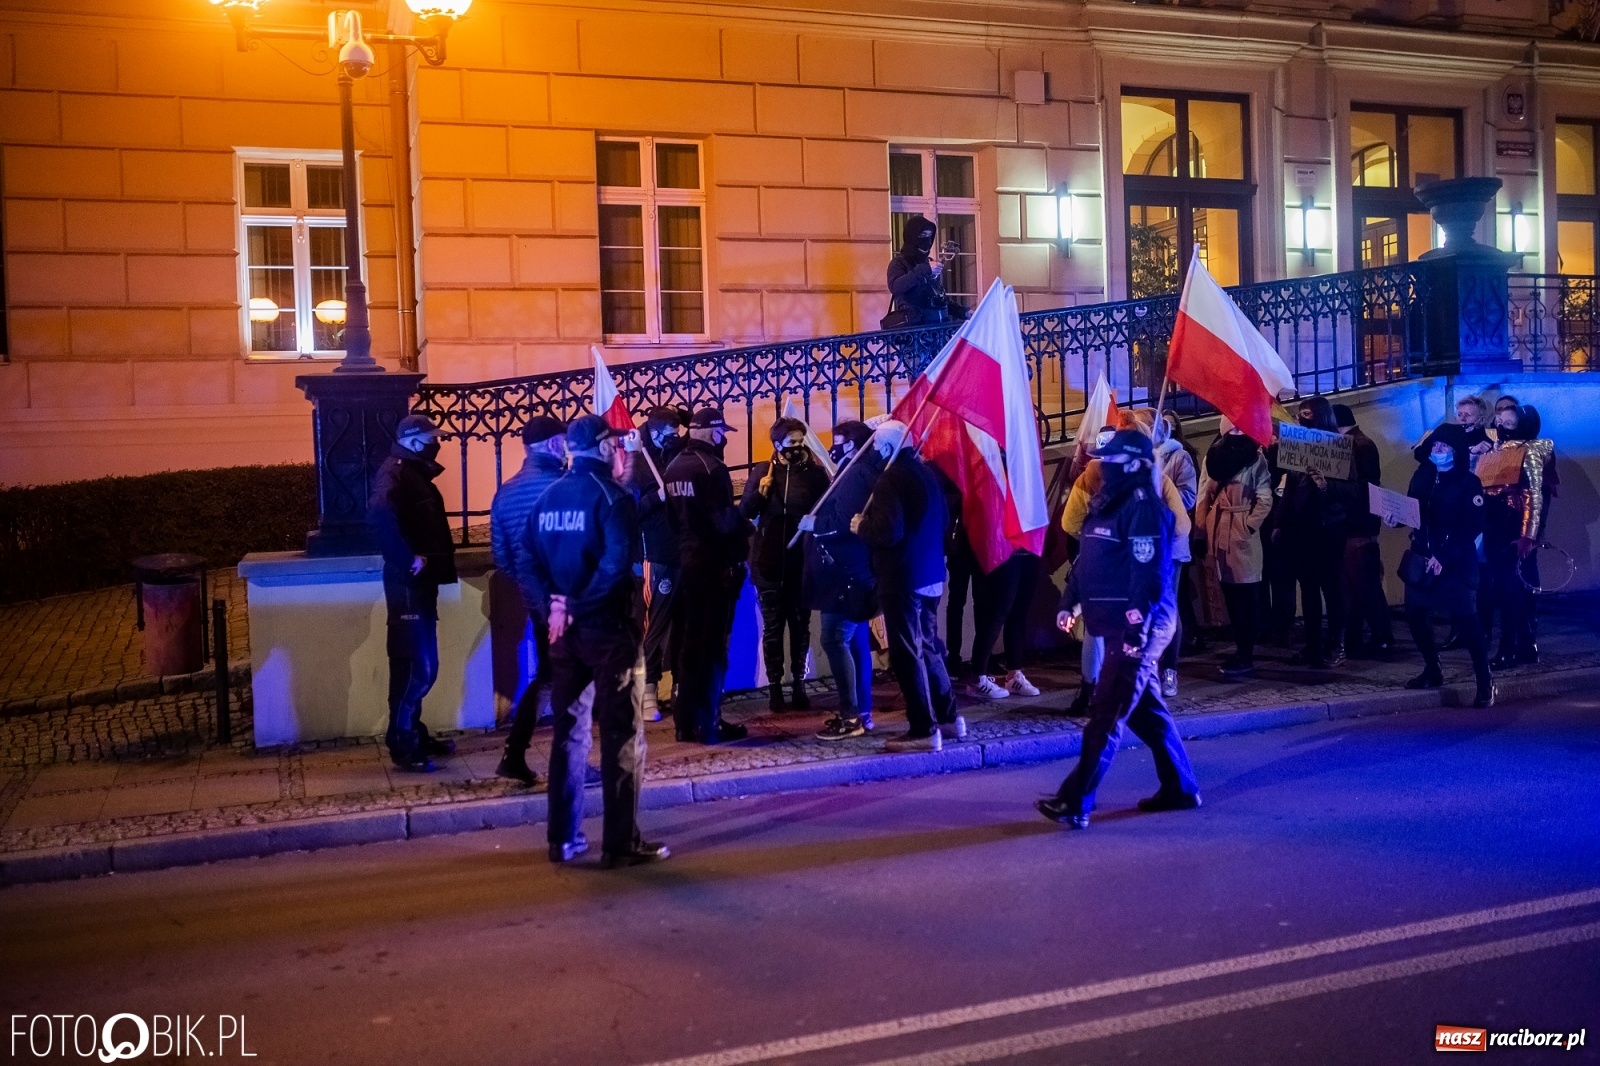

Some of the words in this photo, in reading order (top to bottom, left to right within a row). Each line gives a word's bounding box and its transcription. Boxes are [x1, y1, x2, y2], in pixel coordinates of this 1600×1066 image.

[1280, 438, 1300, 452] WINA
[1304, 443, 1329, 458] TWOJA
[1281, 424, 1307, 441] JAREK
[1311, 431, 1322, 443] TO
[1326, 434, 1352, 450] TWOJA
[1279, 451, 1309, 468] WIELKA
[1313, 459, 1332, 472] WINA
[538, 509, 585, 532] POLICJA
